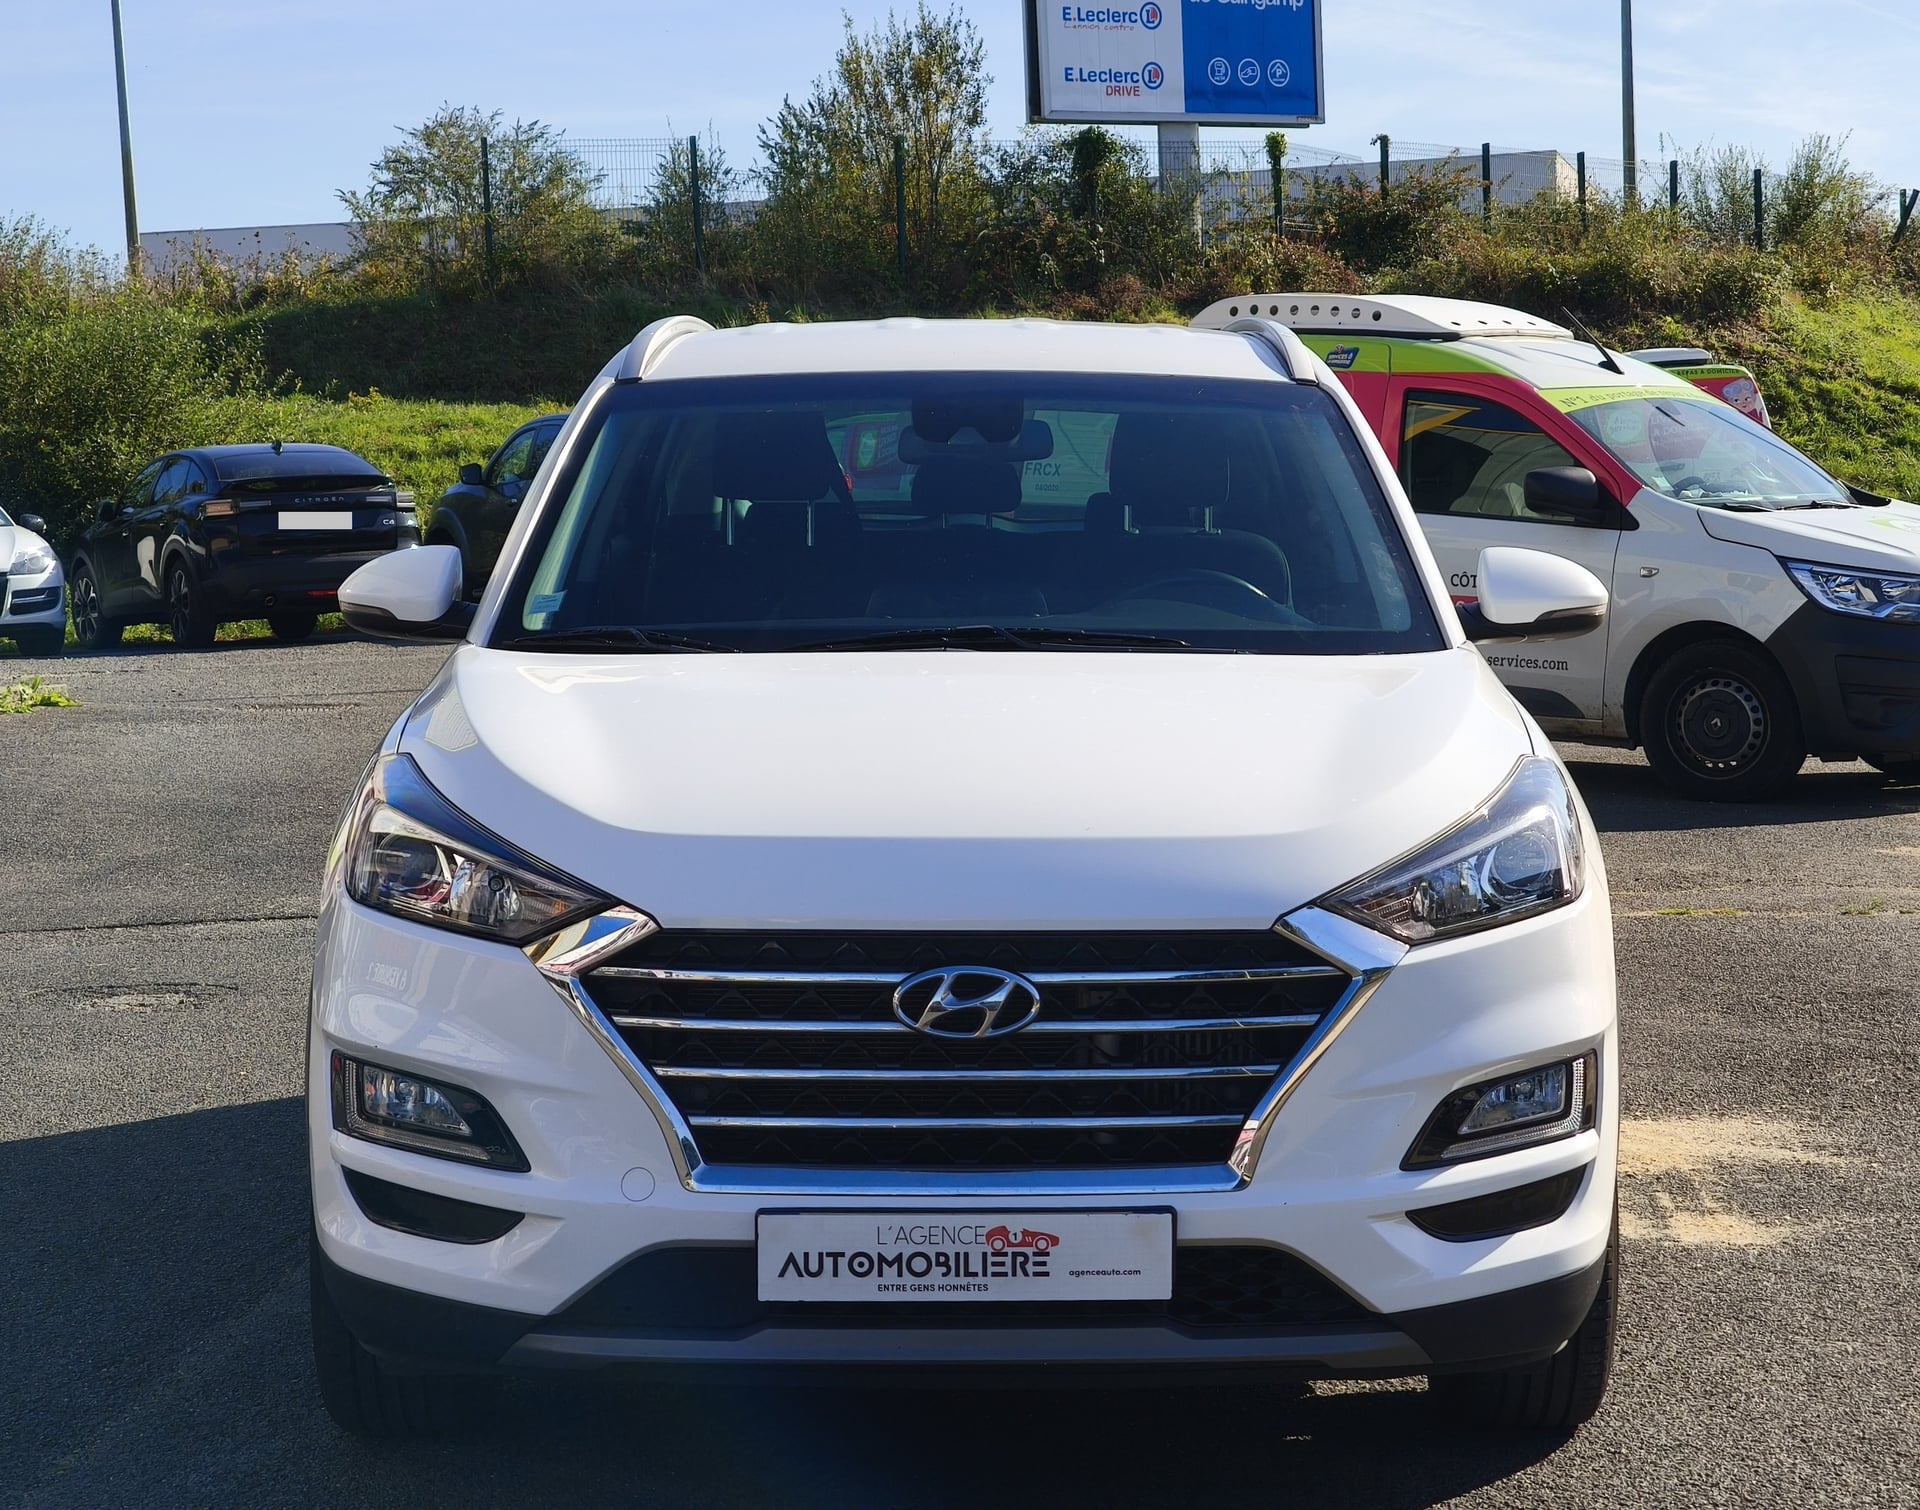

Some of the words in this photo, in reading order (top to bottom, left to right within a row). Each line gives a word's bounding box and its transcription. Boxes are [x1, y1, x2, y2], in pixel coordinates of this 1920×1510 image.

[1062, 6, 1138, 24] E.Leclerc
[1064, 67, 1140, 84] E.Leclerc
[1105, 86, 1140, 96] DRIVE
[1487, 654, 1568, 670] services.com
[876, 1225, 985, 1245] L'AGENCE
[1068, 1268, 1142, 1277] agenceauto.com
[877, 1284, 907, 1292] ENTRE
[910, 1284, 935, 1292] GENS
[938, 1281, 988, 1292] HONNÊTES
